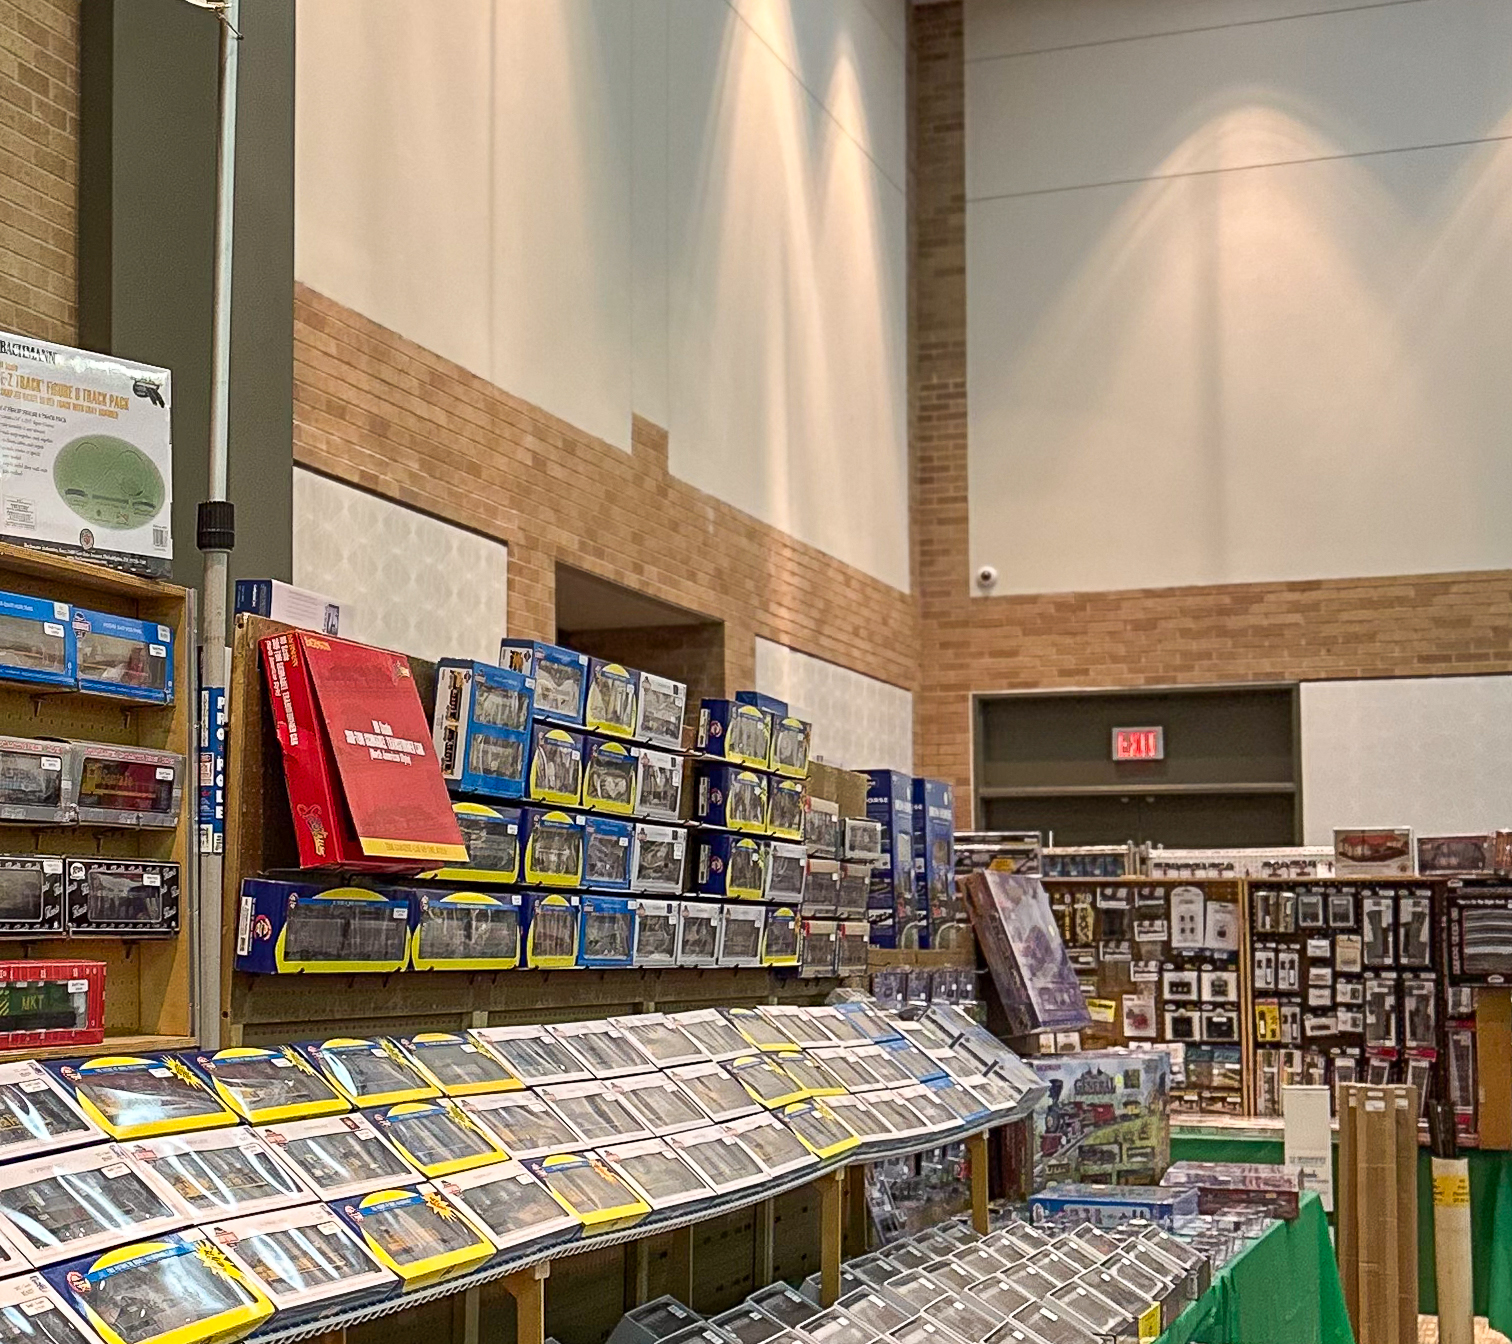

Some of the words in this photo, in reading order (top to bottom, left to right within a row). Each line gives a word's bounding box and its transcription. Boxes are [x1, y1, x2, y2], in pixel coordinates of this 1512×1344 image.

[46, 381, 74, 399] FIGURE
[81, 386, 107, 405] TRACK
[109, 392, 130, 411] PACK
[1117, 732, 1157, 758] EXIT
